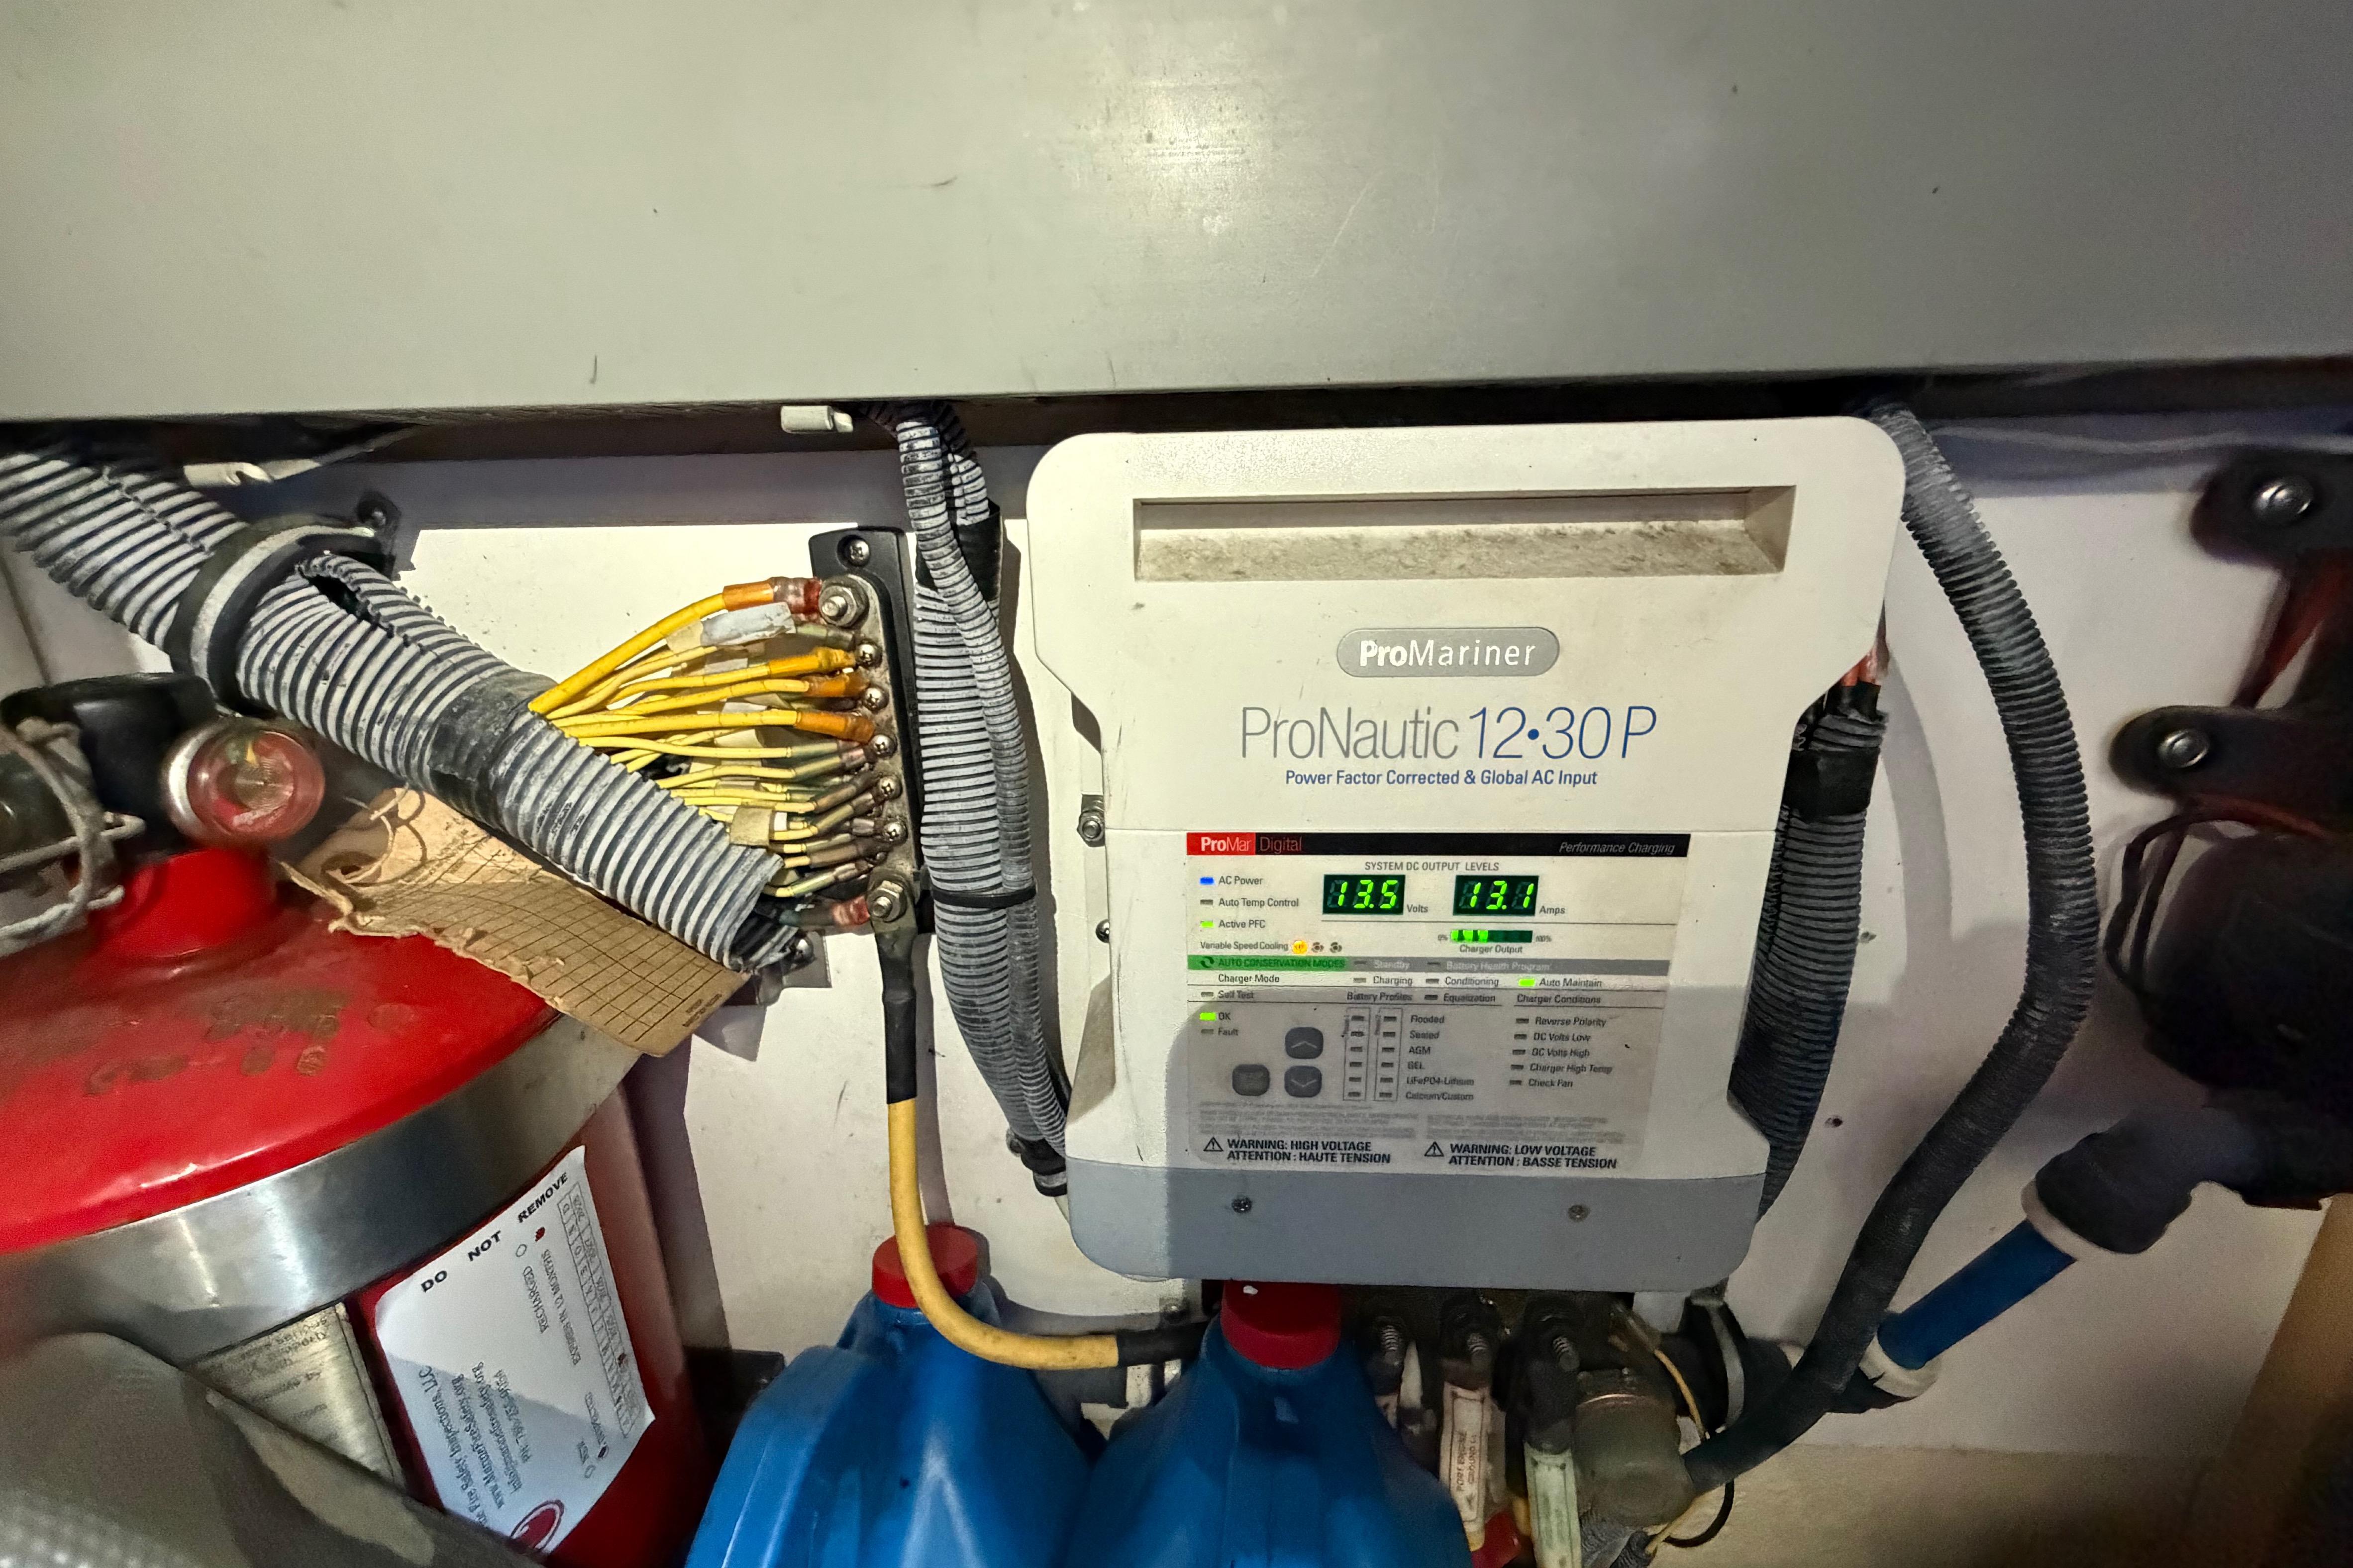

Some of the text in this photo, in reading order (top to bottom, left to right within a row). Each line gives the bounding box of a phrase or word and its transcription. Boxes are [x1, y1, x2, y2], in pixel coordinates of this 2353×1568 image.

[1359, 639, 1535, 667] ProMariner
[1242, 706, 1459, 759] ProNautic
[1622, 706, 1657, 759] P
[1286, 770, 1598, 787] Power Factor Corrected & Global AC Input
[1201, 836, 1302, 854] ProMar Digital
[1559, 842, 1675, 855] Performance Charging
[1365, 862, 1499, 871] SYSTEM DC OUTPUT LEVELS
[1219, 876, 1263, 885] AC Power
[1338, 880, 1398, 908] 13.5
[1470, 881, 1534, 910] 13.1
[1219, 898, 1299, 908] Auto Temp Control
[1407, 904, 1428, 913] Volts
[1539, 906, 1565, 915] Amps
[1233, 941, 1258, 951] Speed
[1259, 942, 1289, 951] Cooling
[1460, 945, 1523, 954] Charger Output
[1219, 959, 1344, 968] AUTO CONSERVATION MODES
[1374, 960, 1410, 970] Standby
[1446, 961, 1479, 971] Battery
[1512, 962, 1549, 973] Program
[1219, 974, 1252, 983] Charger
[1373, 976, 1413, 986] Charging
[1445, 977, 1499, 986] Conditioning
[1539, 978, 1602, 987] Auto Maintain
[1237, 990, 1254, 999] Test
[1347, 991, 1412, 1001] Battery Profiles
[1444, 993, 1496, 1002] Equalization
[1517, 994, 1601, 1004] Charger Conditions
[1411, 1015, 1445, 1023] Flooded
[1535, 1017, 1606, 1027] Reverse Polarity
[1410, 1030, 1439, 1039] Sealed
[1549, 1033, 1569, 1041] Volts
[1409, 1046, 1431, 1055] AGM
[1570, 1049, 1590, 1058] High
[1407, 1061, 1425, 1070] GEL
[1530, 1064, 1565, 1074] Charger
[1529, 1078, 1554, 1087] Check
[1228, 1139, 1371, 1151] WARNING: HIGH VOLTAGE
[1450, 1144, 1596, 1156] WARNING: LOW VOLTAGE
[1227, 1152, 1291, 1161] ATTENTION
[1299, 1153, 1337, 1162] HAUTE
[1341, 1153, 1391, 1164] TENSION
[1448, 1156, 1514, 1166] ATTENTION
[1523, 1157, 1561, 1167] BASSE
[1565, 1158, 1617, 1169] TENSION
[421, 1172, 568, 1293] DO NOT REMOVE
[523, 1266, 549, 1334] RECHARGED
[419, 1365, 438, 1392] LLC
[468, 1488, 480, 1512] Fire
